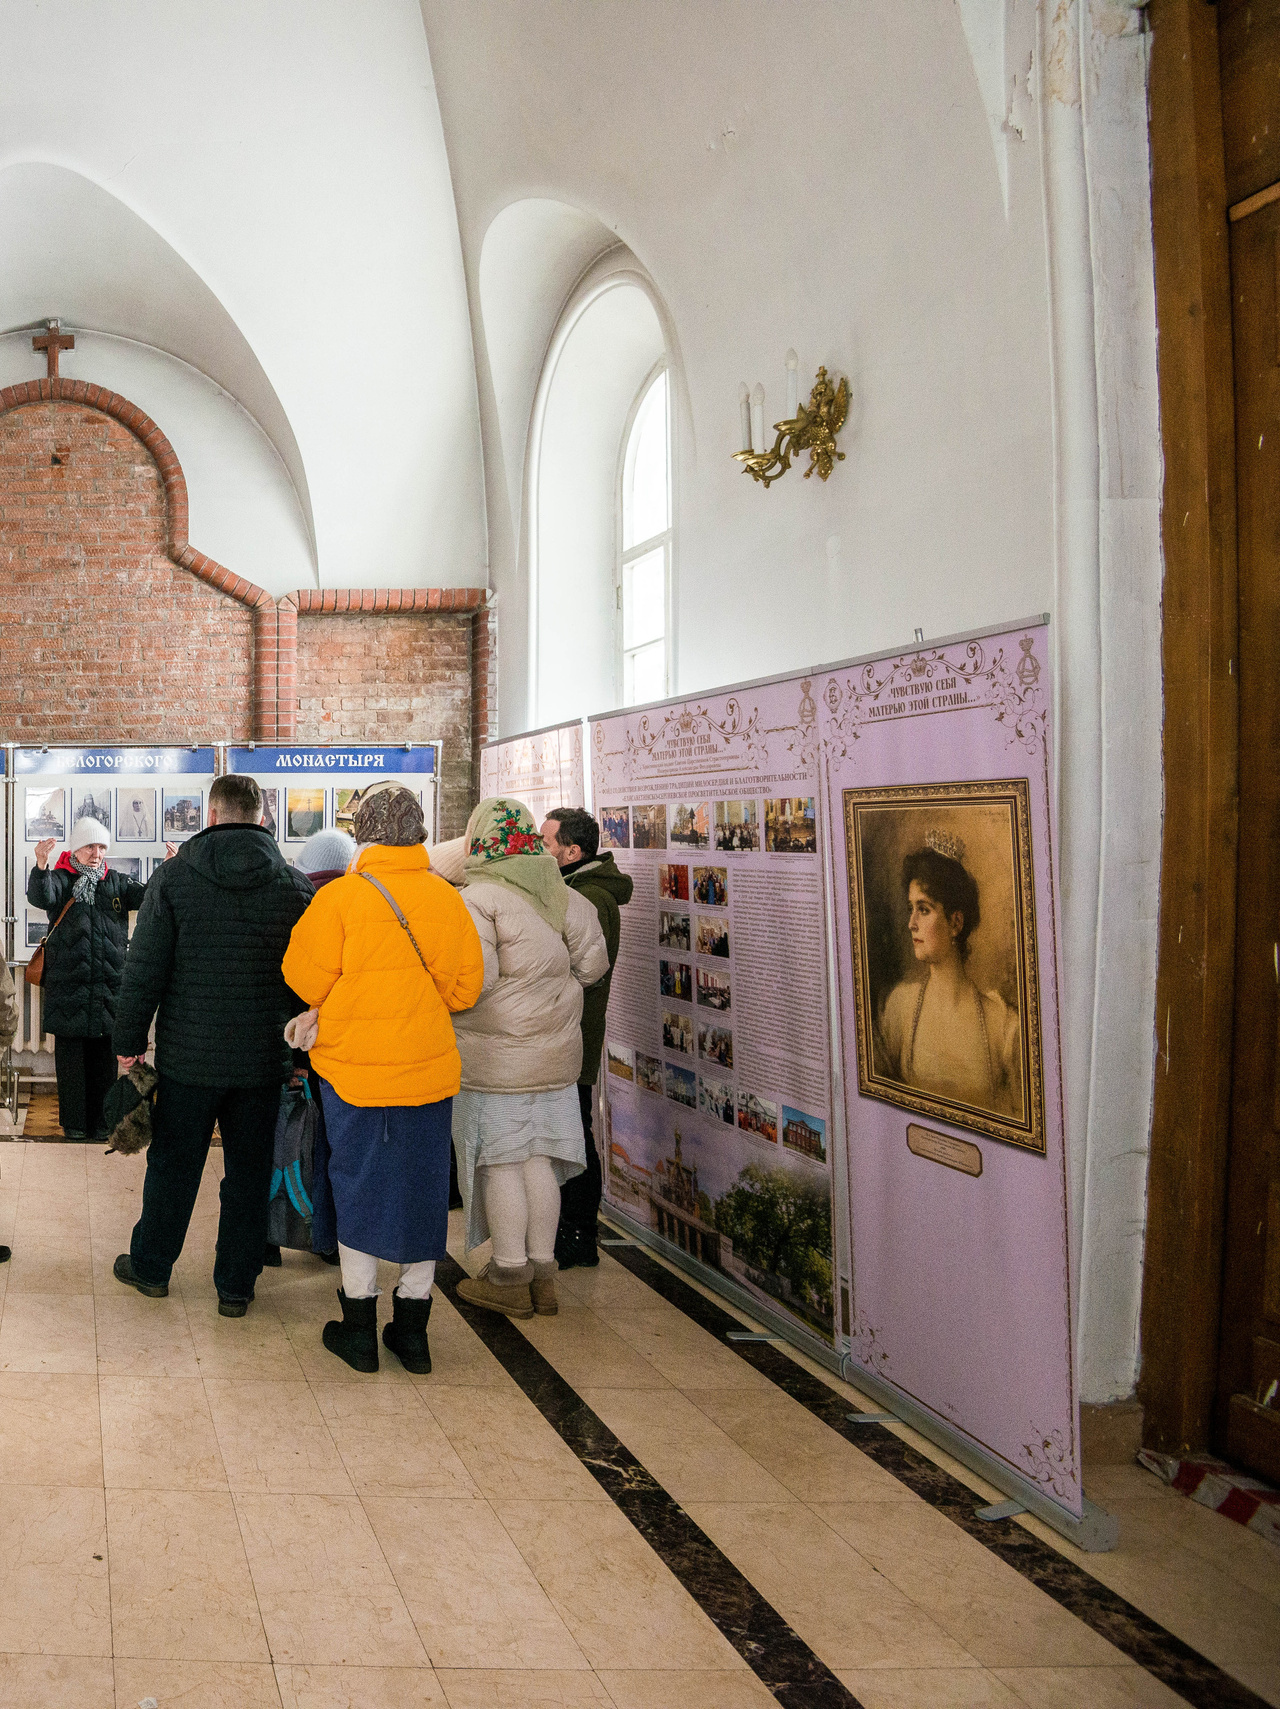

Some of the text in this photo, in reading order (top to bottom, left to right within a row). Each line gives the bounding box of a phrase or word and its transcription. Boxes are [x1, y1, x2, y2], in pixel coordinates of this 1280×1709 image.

[936, 677, 957, 690] СЕБЯ
[868, 701, 906, 718] МАТЕРЬЮ
[908, 696, 929, 711] ЭТОЙ
[697, 734, 711, 745] СЕБЯ
[651, 750, 677, 761] МАТЕРЬЮ
[679, 746, 693, 758] ЭТОЙ
[275, 754, 385, 767] МОНАСТЫРЯ
